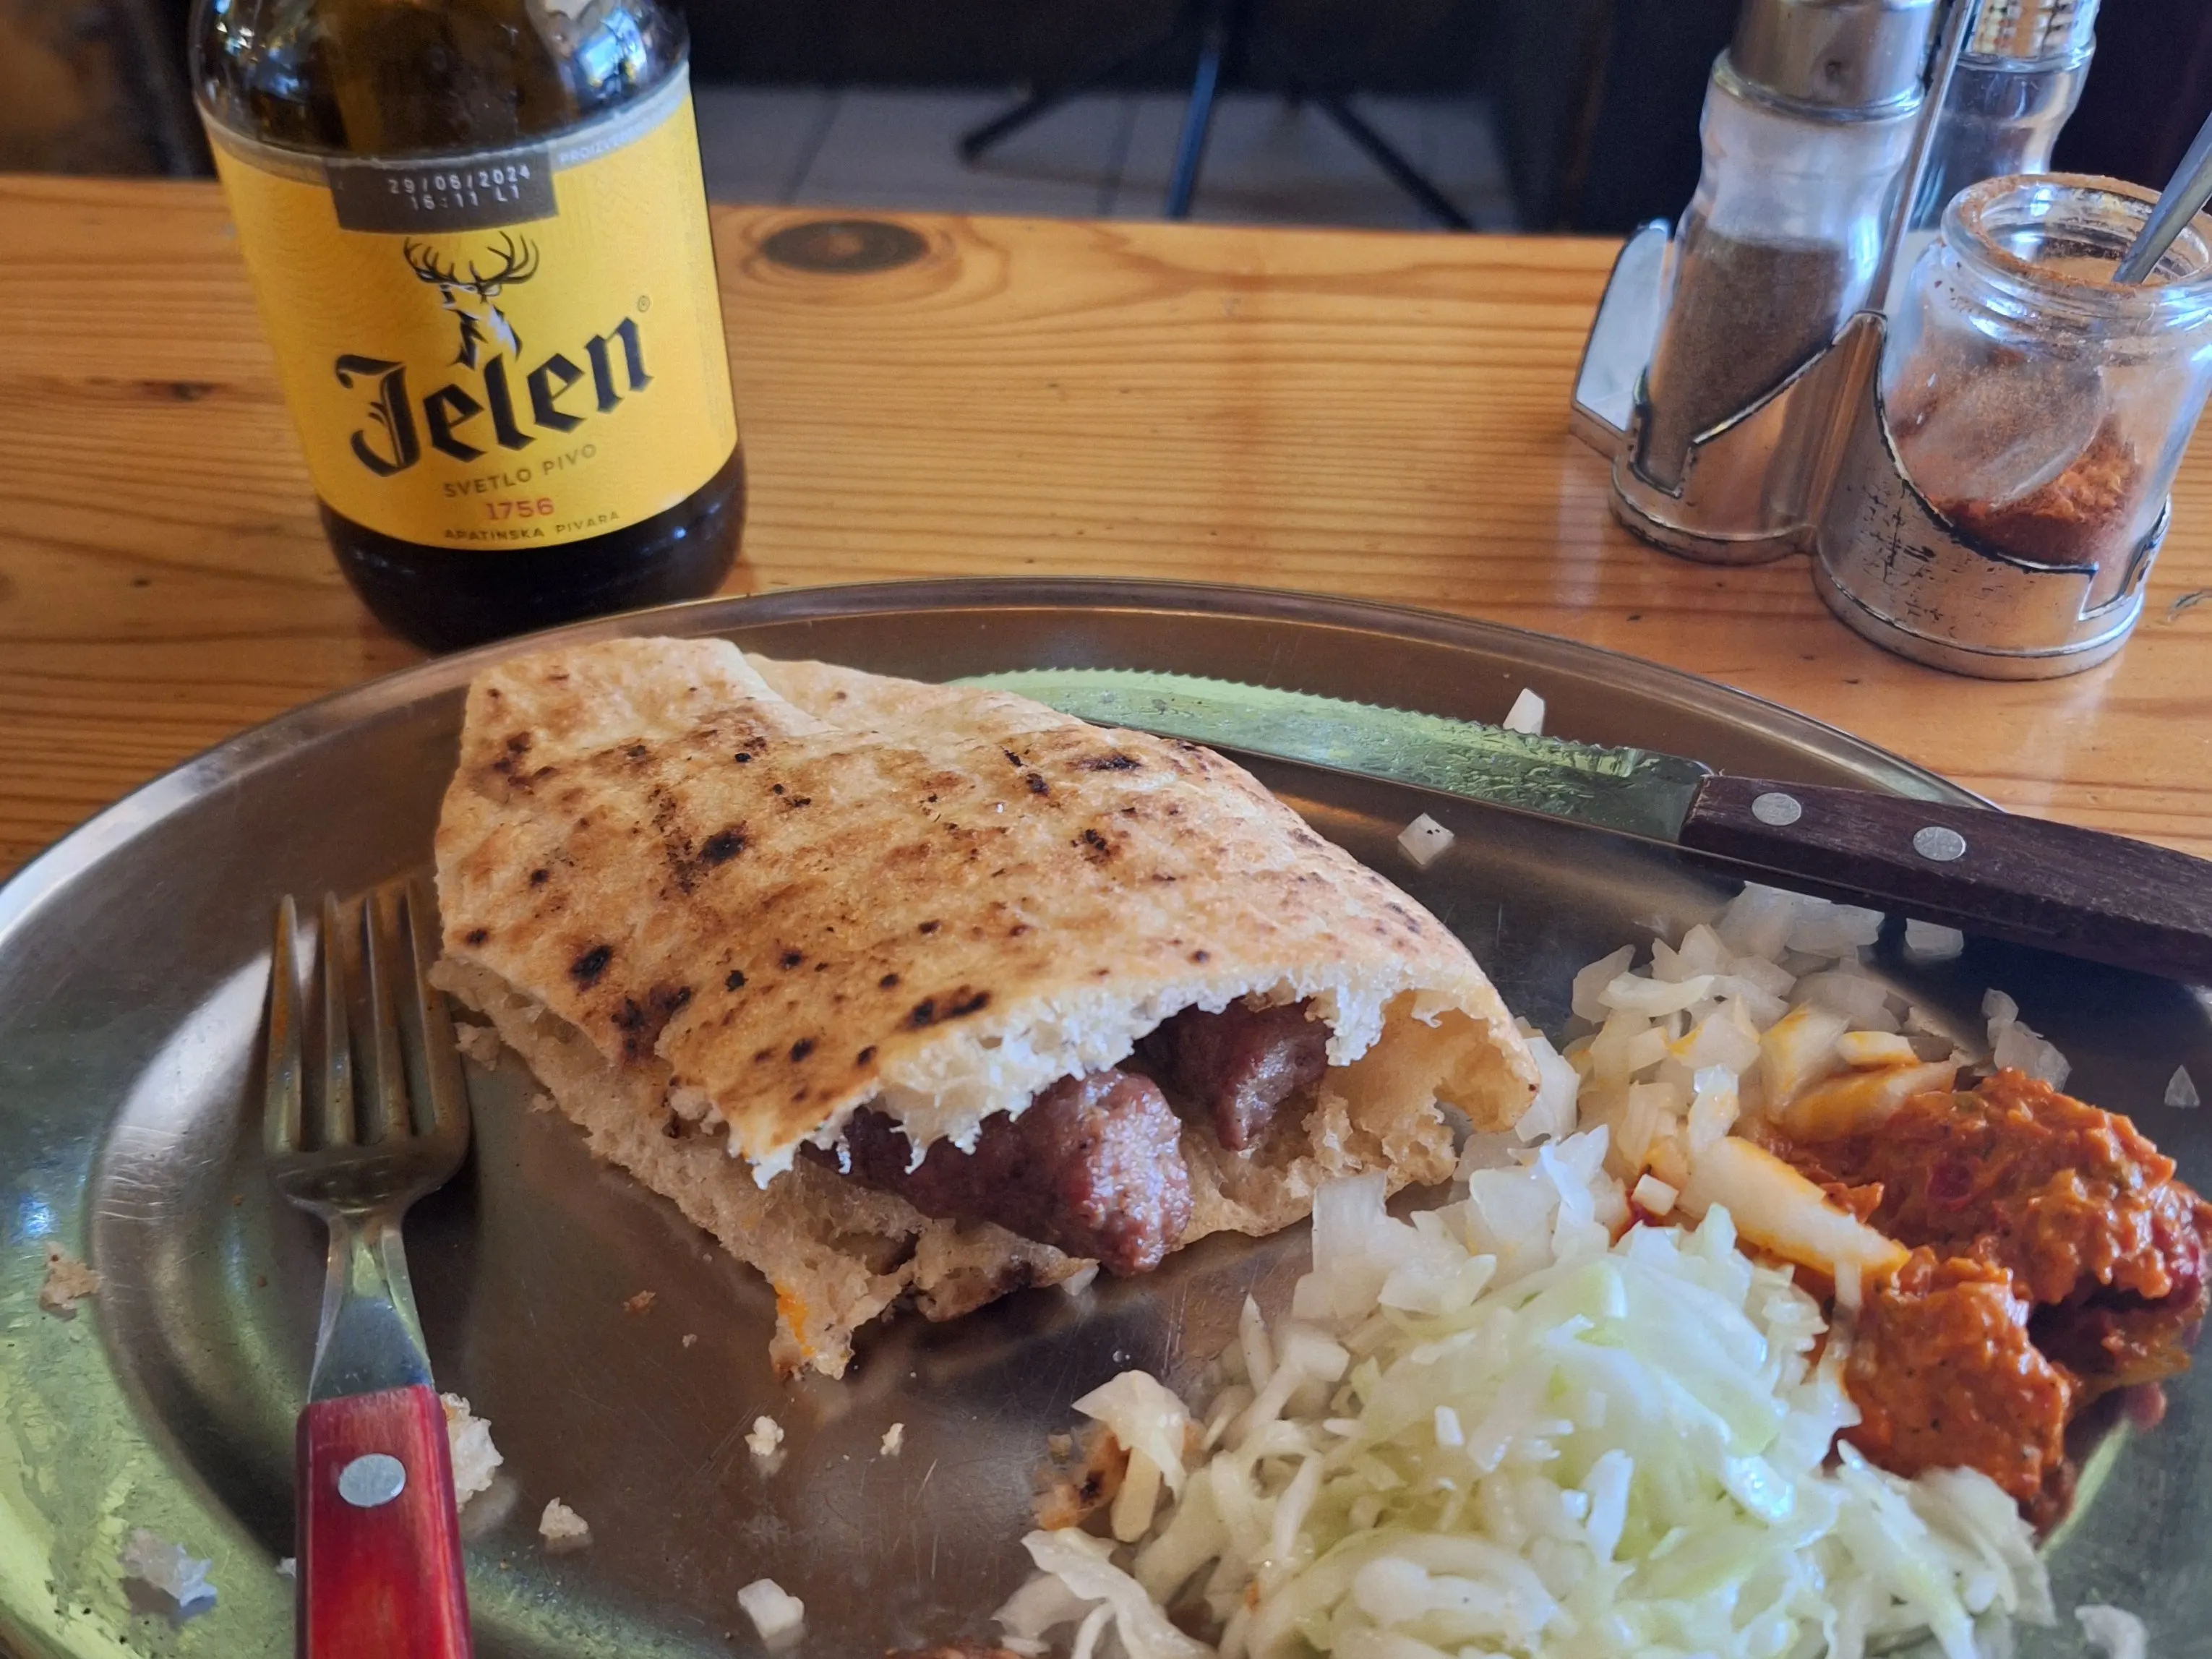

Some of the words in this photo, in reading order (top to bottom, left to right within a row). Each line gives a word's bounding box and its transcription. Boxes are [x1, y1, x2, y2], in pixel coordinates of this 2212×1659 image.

[335, 316, 655, 478] Jelen
[443, 468, 532, 497] SVETLO
[542, 444, 597, 476] PIVO
[444, 527, 545, 541] APATINSKA
[555, 511, 622, 533] PIVARA
[486, 497, 555, 520] 1756
